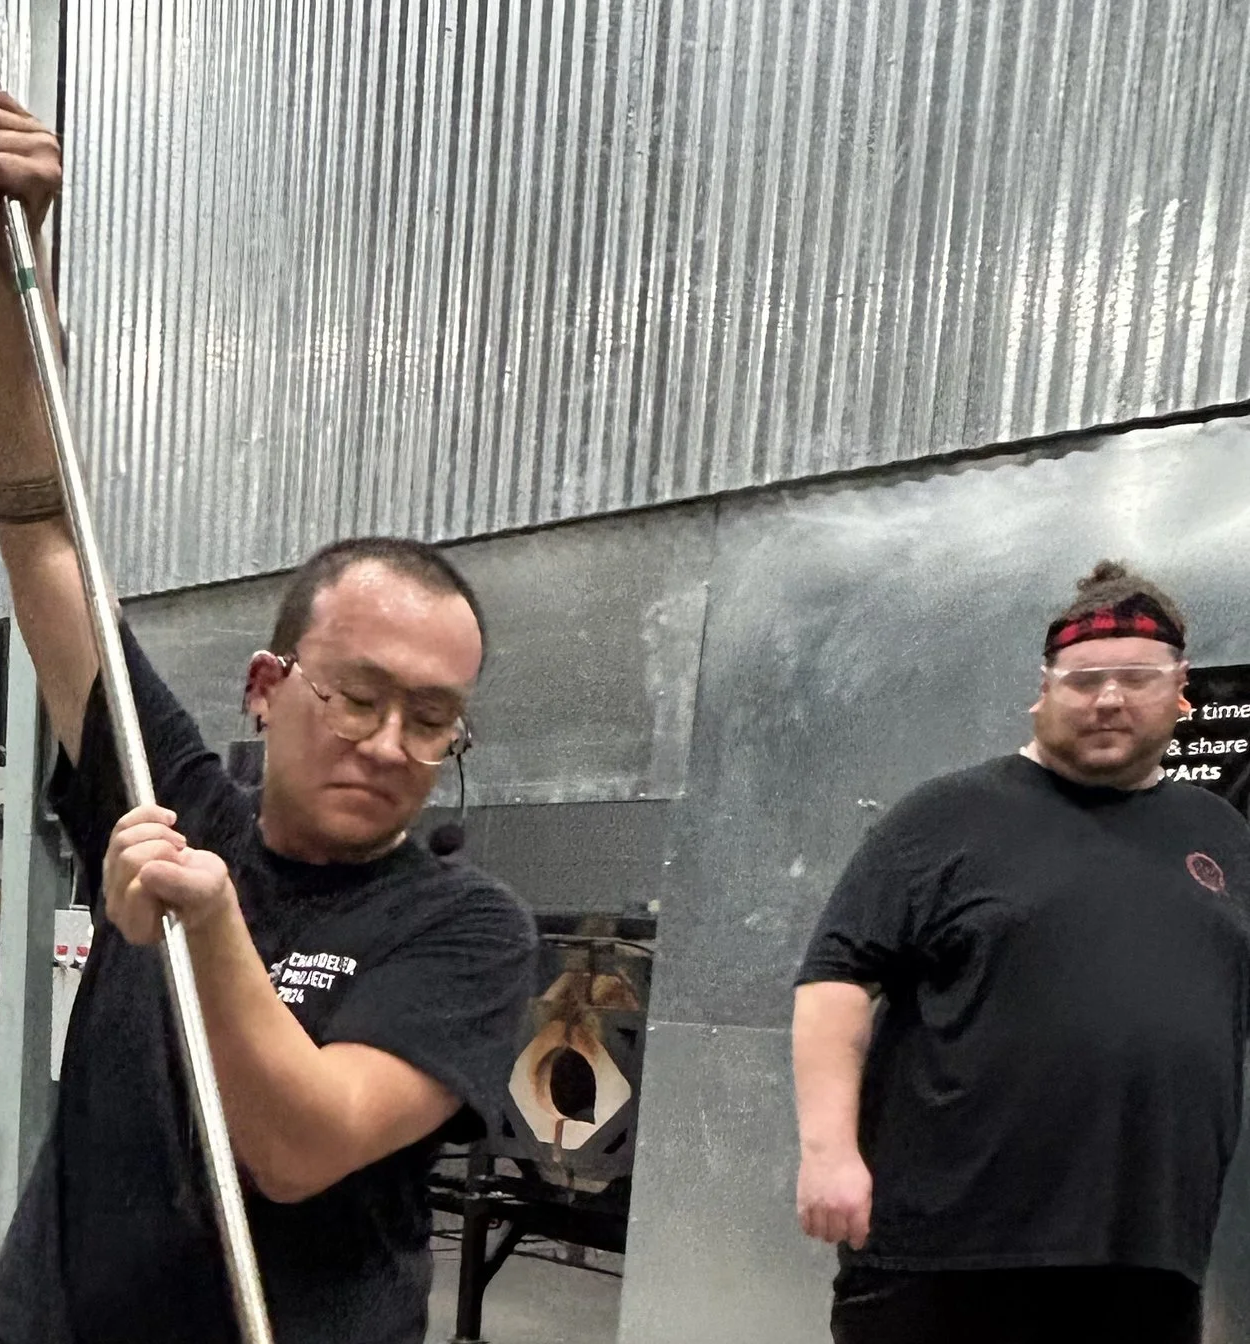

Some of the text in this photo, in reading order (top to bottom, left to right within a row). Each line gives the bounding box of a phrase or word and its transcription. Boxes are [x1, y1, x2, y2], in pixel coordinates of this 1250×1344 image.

[1166, 736, 1249, 756] & share
[281, 968, 335, 991] PROJECT
[276, 985, 305, 1004] 2024
